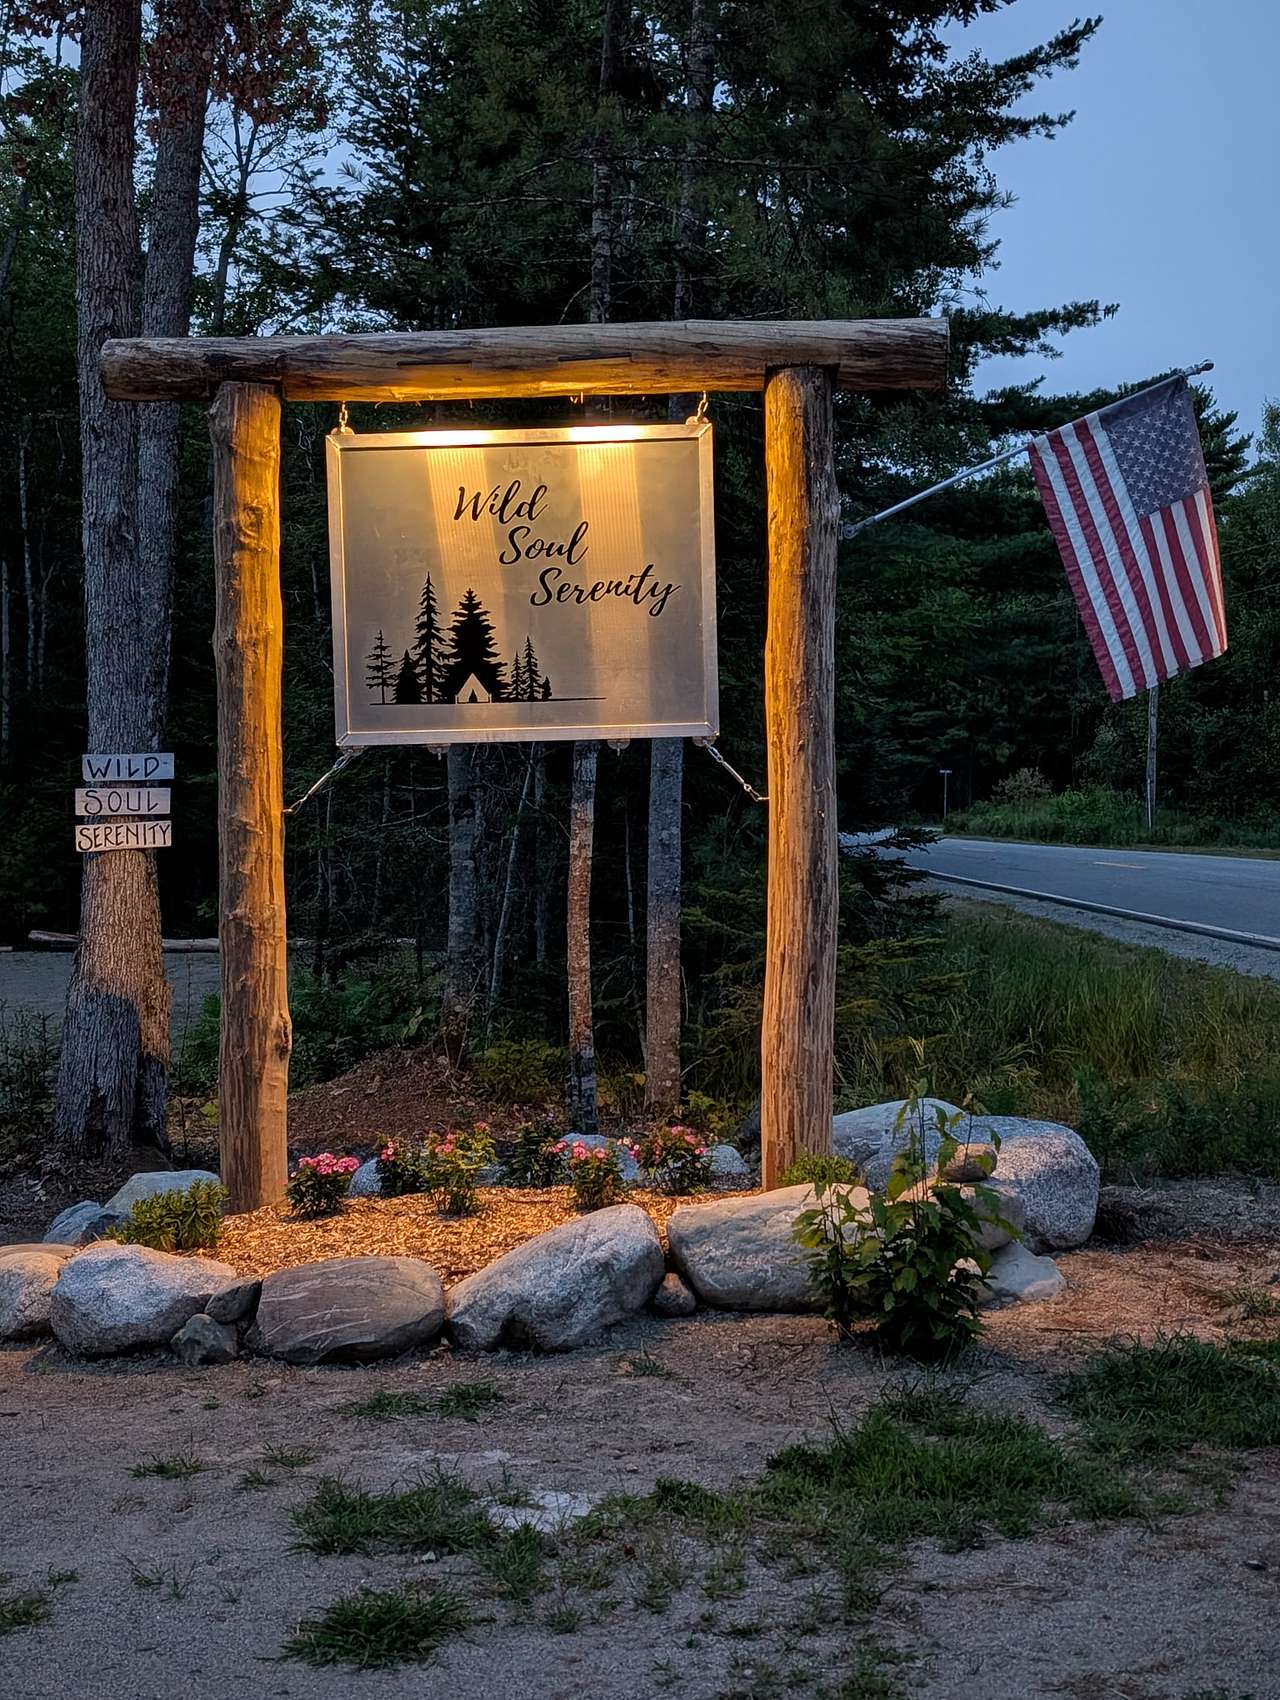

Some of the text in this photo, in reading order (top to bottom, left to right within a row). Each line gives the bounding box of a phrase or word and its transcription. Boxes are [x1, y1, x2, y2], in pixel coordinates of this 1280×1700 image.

[453, 480, 548, 524] Wild
[499, 521, 589, 565] Soul
[530, 564, 681, 616] Serenity
[84, 790, 158, 815] SOUL
[78, 823, 170, 850] SERENITY
